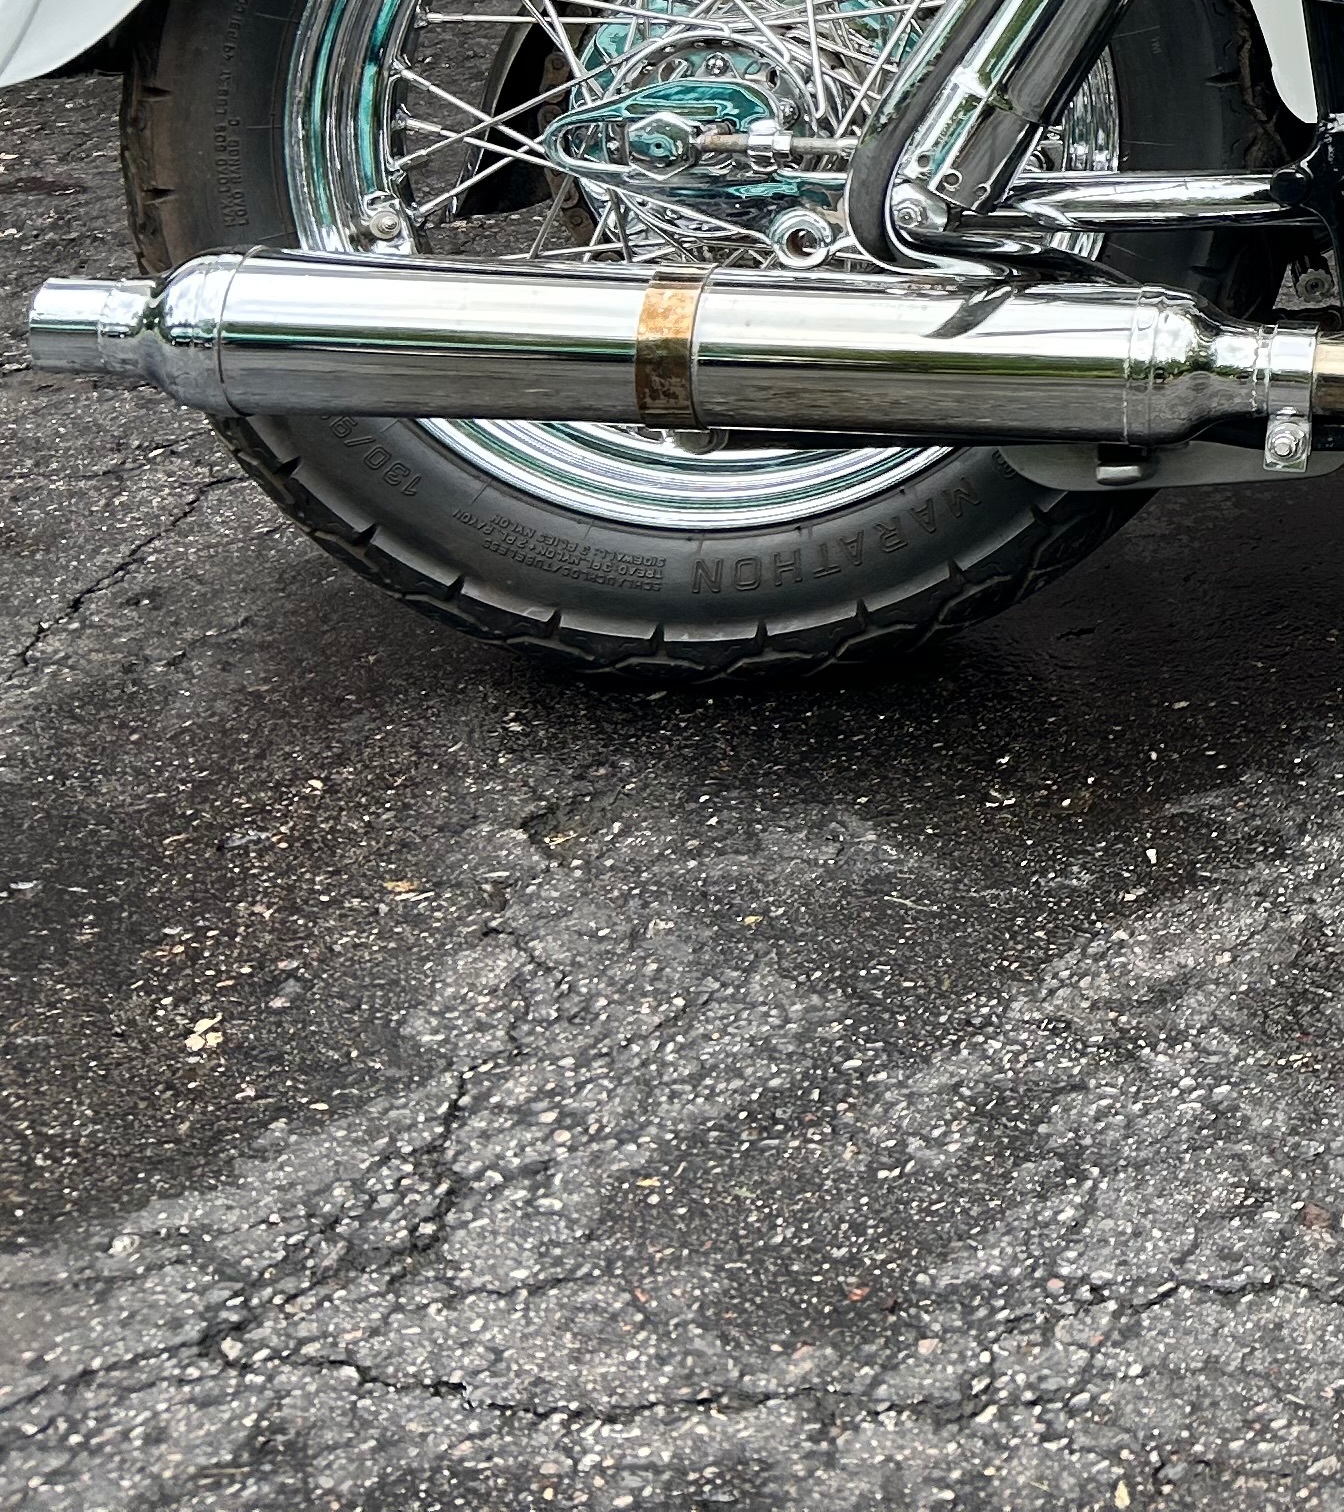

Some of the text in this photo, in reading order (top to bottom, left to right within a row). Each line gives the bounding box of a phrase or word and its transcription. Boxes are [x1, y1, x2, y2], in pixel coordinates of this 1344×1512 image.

[214, 157, 232, 194] LOAD
[231, 190, 251, 227] LOAD
[318, 415, 423, 498] 130/9
[490, 514, 537, 539] NYLON
[690, 477, 984, 595] MARATHON
